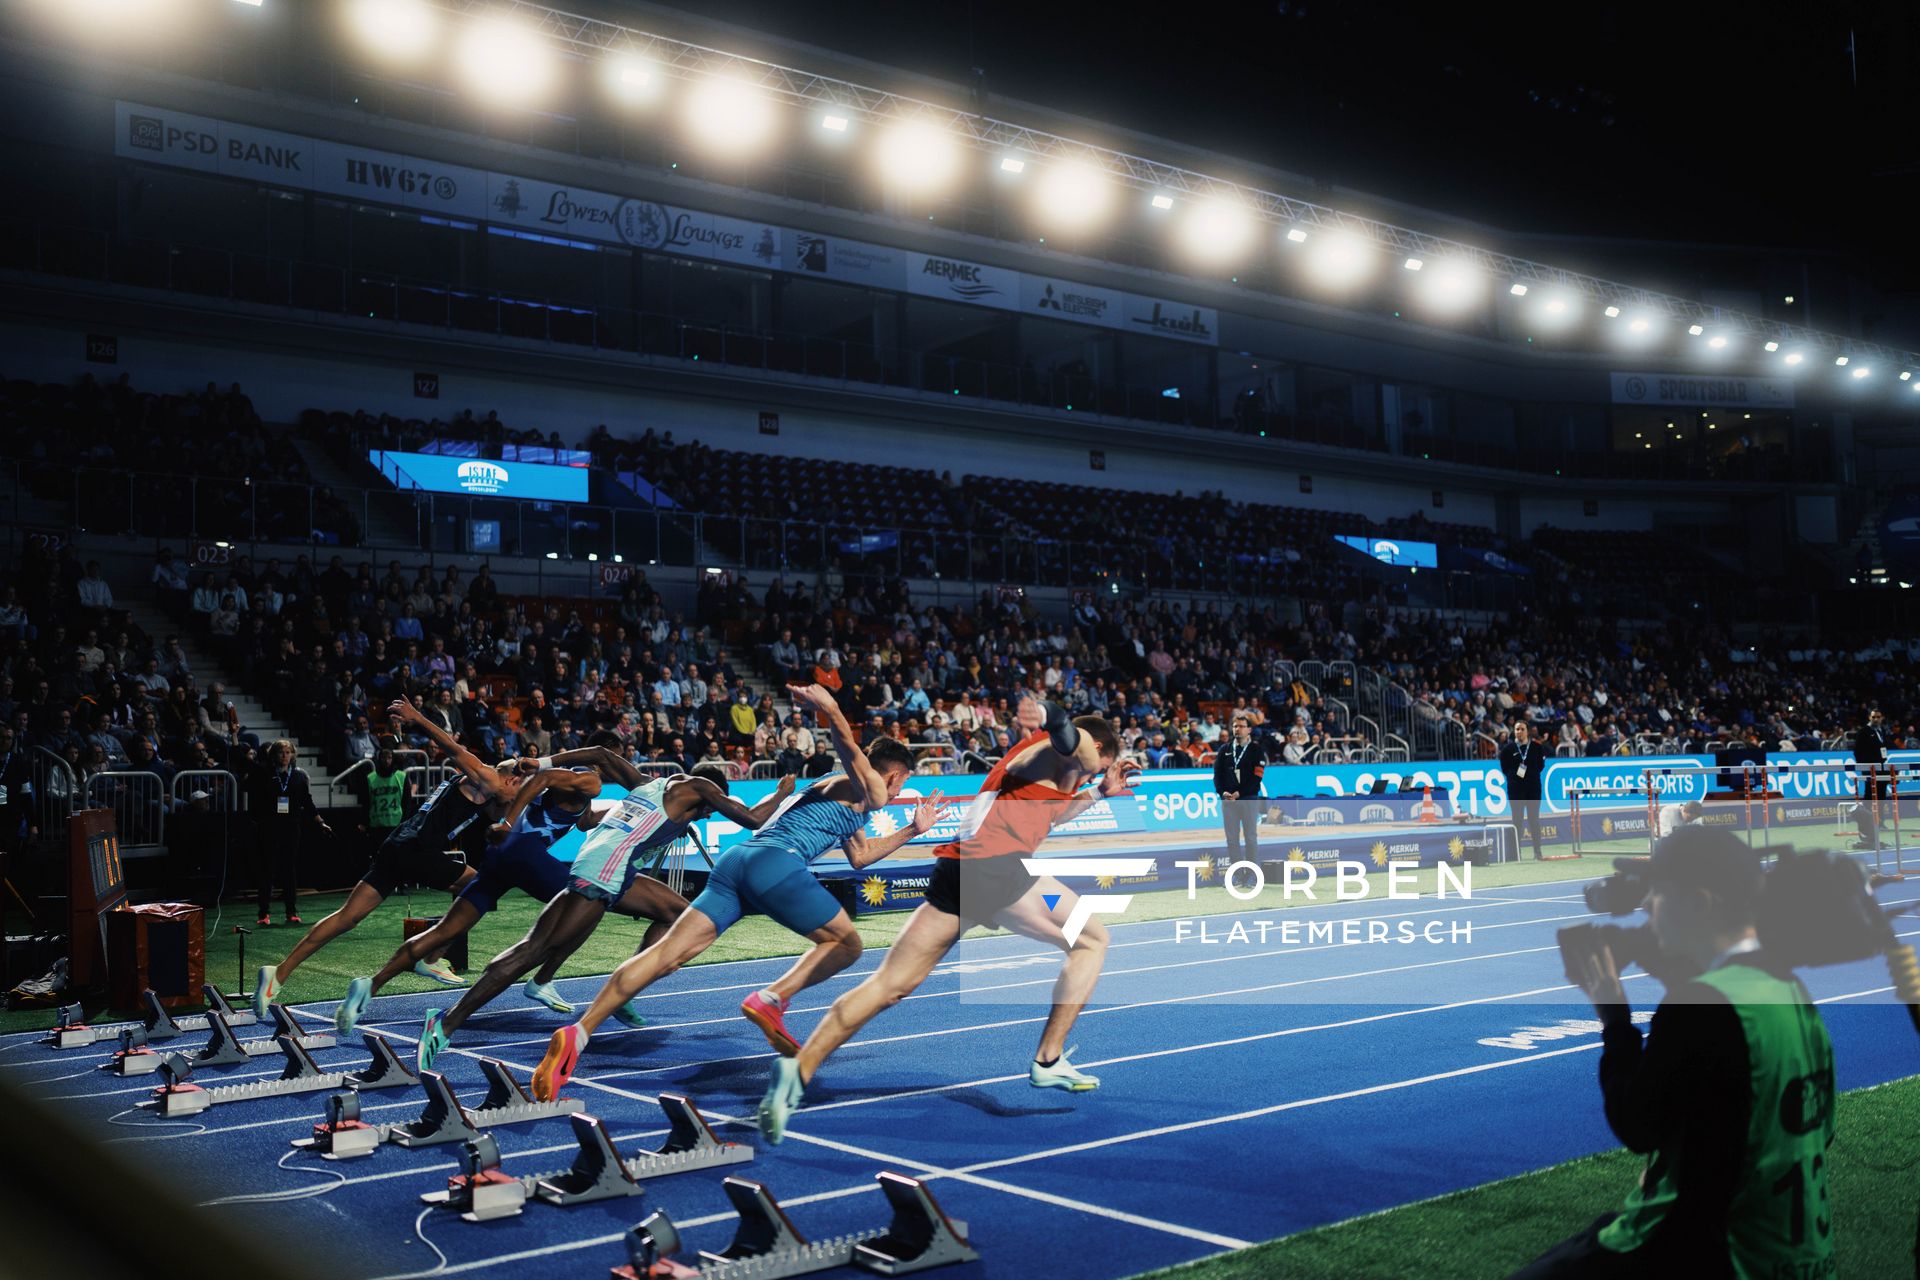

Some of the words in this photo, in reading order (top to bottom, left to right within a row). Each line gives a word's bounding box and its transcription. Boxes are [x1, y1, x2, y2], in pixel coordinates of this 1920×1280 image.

[167, 127, 218, 154] PSD
[228, 139, 301, 171] BANK
[345, 159, 432, 196] HW67
[923, 257, 981, 283] AERMEC
[1063, 302, 1102, 319] ELECTRIC
[91, 343, 115, 357] 126
[417, 379, 436, 393] 127
[1659, 379, 1748, 401] SPORTSBAR
[468, 465, 497, 479] ISTAF
[198, 546, 230, 563] 023
[604, 570, 629, 584] 024
[1562, 777, 1611, 799] HOME
[1613, 776, 1635, 798] OF
[1153, 792, 1220, 821] SPOR
[1614, 819, 1646, 831] MERKUR
[1307, 849, 1340, 860] MERKUR
[1389, 843, 1420, 854] MERKUR
[891, 877, 930, 889] MERKU
